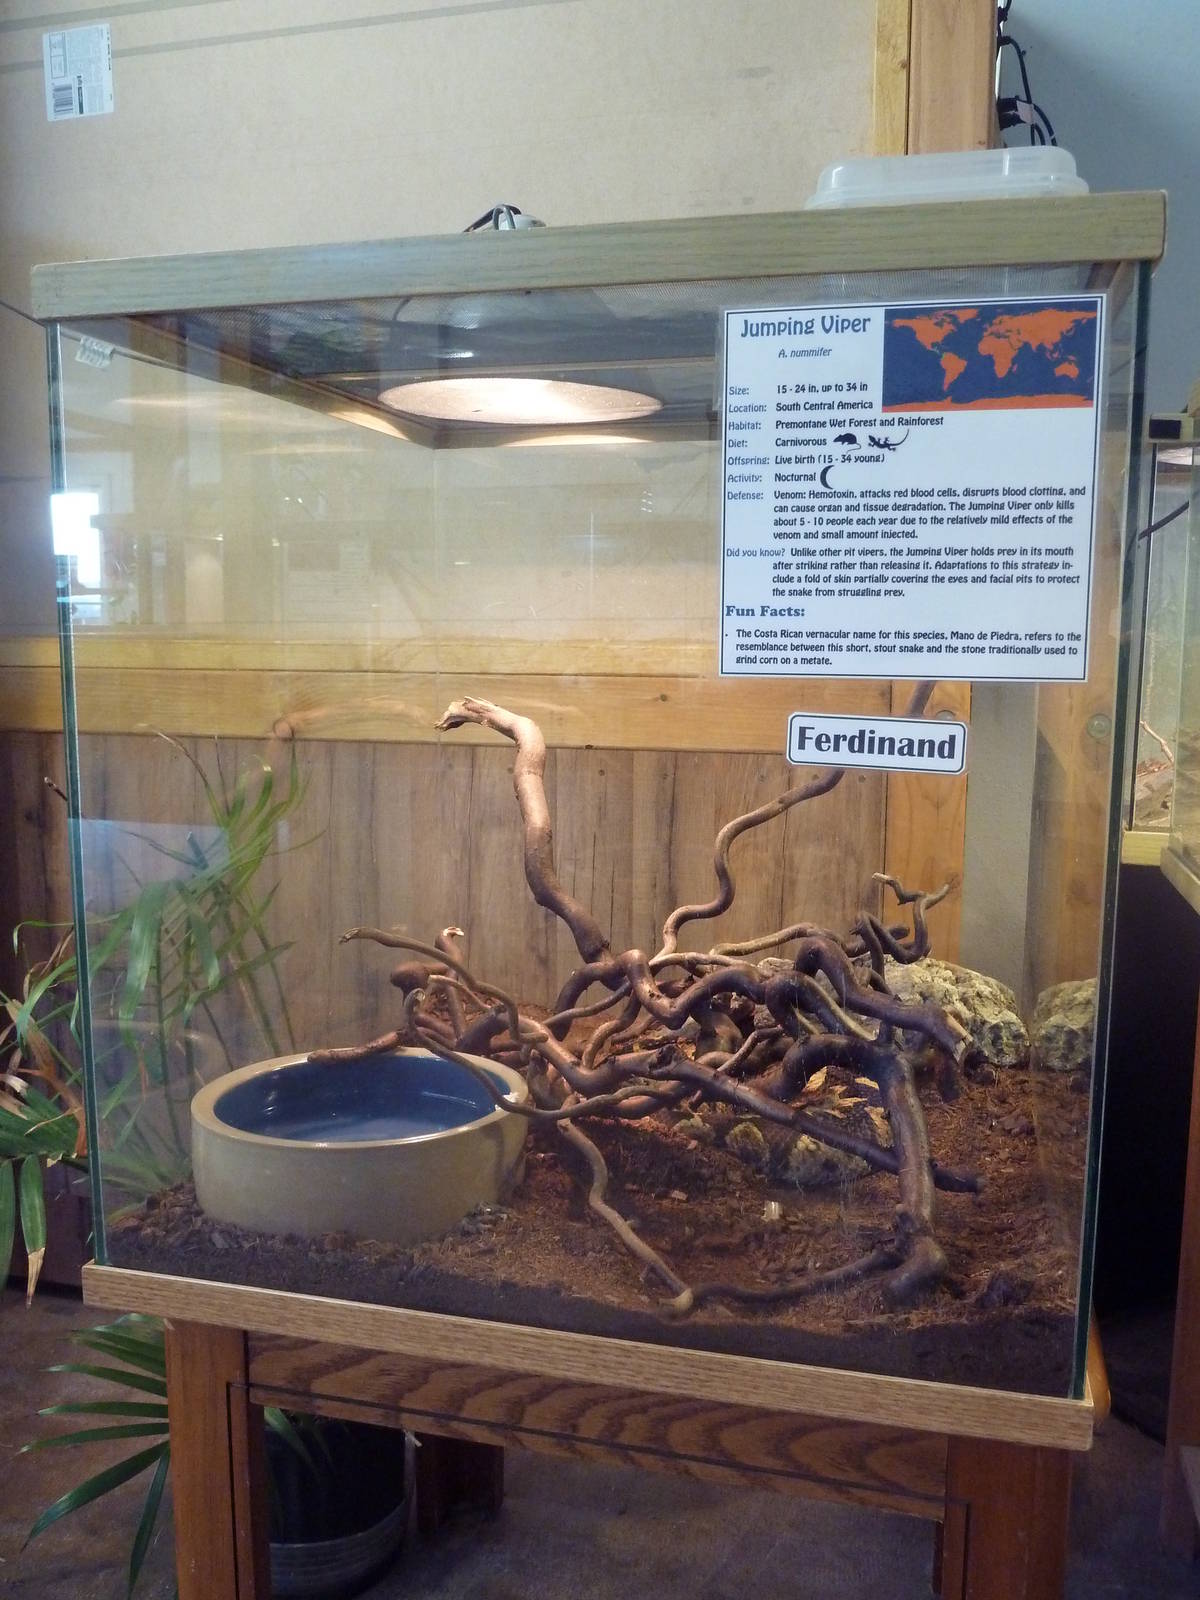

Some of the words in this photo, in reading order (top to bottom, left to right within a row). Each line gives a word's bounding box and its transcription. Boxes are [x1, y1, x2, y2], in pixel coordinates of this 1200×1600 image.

[741, 317, 815, 337] Jumping
[821, 315, 871, 334] Viper
[779, 349, 787, 358] A.
[790, 347, 832, 357] nummifer
[729, 387, 749, 395] Size:
[778, 385, 787, 393] 15
[795, 385, 805, 393] 24
[835, 384, 843, 392] to
[847, 383, 857, 391] 34
[860, 383, 867, 391] in
[729, 404, 766, 413] Location:
[776, 402, 800, 411] South
[804, 401, 834, 410] Central
[837, 401, 873, 409] America
[729, 422, 761, 430] Habitat:
[776, 420, 826, 429] Premontane
[830, 419, 846, 427] Wet
[849, 418, 876, 427] Forest
[880, 418, 895, 426] and
[898, 417, 943, 426] Rainforest
[728, 439, 747, 447] Diet:
[776, 438, 827, 446] Carnivorous
[728, 456, 769, 465] Offspring:
[775, 456, 792, 464] Live
[795, 455, 815, 464] birth
[818, 455, 833, 463] (15
[841, 455, 852, 463] 34
[854, 454, 884, 463] young)
[775, 473, 816, 481] Nocturnal
[728, 491, 763, 500] Defense:
[774, 491, 806, 499] Venom:
[860, 489, 891, 498] attacks
[894, 489, 908, 497] red
[911, 488, 934, 497] blood
[963, 488, 999, 496] disrupts
[1003, 487, 1026, 496] blood
[1069, 486, 1085, 495] and
[845, 503, 860, 511] and
[863, 503, 889, 512] tissue
[892, 502, 946, 511] degradation.
[949, 502, 965, 510] The
[968, 501, 1004, 510] Jumping
[1008, 501, 1032, 510] Viper
[1035, 501, 1053, 510] only
[1057, 500, 1074, 509] kills
[774, 518, 797, 526] about
[800, 517, 805, 526] 5
[814, 517, 823, 525] 10
[826, 516, 853, 525] people
[856, 516, 876, 525] each
[900, 516, 916, 525] due
[931, 516, 944, 524] the
[947, 515, 987, 524] relatively
[991, 515, 1009, 524] mild
[1012, 515, 1043, 524] effects
[1046, 515, 1056, 524] of
[1059, 514, 1072, 524] the
[804, 530, 818, 539] and
[822, 530, 843, 539] small
[881, 530, 918, 538] injected.
[727, 548, 739, 557] Did
[760, 548, 785, 556] know?
[791, 548, 816, 556] Unlike
[819, 548, 842, 556] other
[844, 548, 855, 556] pit
[890, 548, 903, 556] the
[906, 547, 941, 556] Jumping
[945, 547, 968, 556] Viper
[971, 547, 994, 556] holds
[1020, 547, 1028, 555] in
[1031, 547, 1042, 556] its
[1045, 547, 1073, 555] mouth
[773, 561, 793, 569] after
[796, 561, 827, 569] striking
[831, 561, 857, 569] rather
[860, 561, 878, 569] than
[881, 561, 920, 569] releasing
[923, 561, 931, 569] it.
[935, 561, 987, 569] Adaptations
[990, 561, 999, 569] to
[1003, 561, 1018, 569] this
[1022, 561, 1059, 569] strategy
[773, 574, 794, 583] clude
[805, 574, 820, 583] fold
[823, 575, 831, 583] of
[834, 574, 851, 583] skin
[854, 574, 889, 583] partially
[891, 575, 928, 583] covering
[932, 574, 945, 583] the
[971, 575, 986, 583] and
[990, 574, 1013, 583] facial
[1016, 575, 1032, 583] pits
[773, 588, 785, 596] the
[788, 588, 812, 596] snake
[815, 588, 835, 596] from
[838, 588, 881, 596] struggling
[726, 606, 755, 616] Fun
[760, 606, 804, 616] Facts:
[736, 629, 751, 637] The
[754, 629, 777, 638] Costa
[781, 630, 803, 638] Rican
[806, 630, 850, 638] vernacular
[879, 630, 891, 639] for
[894, 631, 910, 639] this
[951, 631, 974, 640] Mano
[977, 632, 987, 640] de
[1025, 632, 1051, 640] refers
[1055, 633, 1064, 641] to
[1068, 632, 1081, 641] the
[736, 643, 788, 651] resemblance
[791, 643, 824, 651] between
[828, 643, 843, 652] this
[899, 644, 924, 653] snake
[927, 644, 942, 653] and
[945, 645, 958, 653] the
[989, 645, 1041, 654] traditionally
[1045, 646, 1065, 654] used
[1069, 647, 1077, 655] to
[736, 655, 757, 664] grind
[801, 657, 832, 665] metate.
[797, 726, 956, 760] Ferdinand
